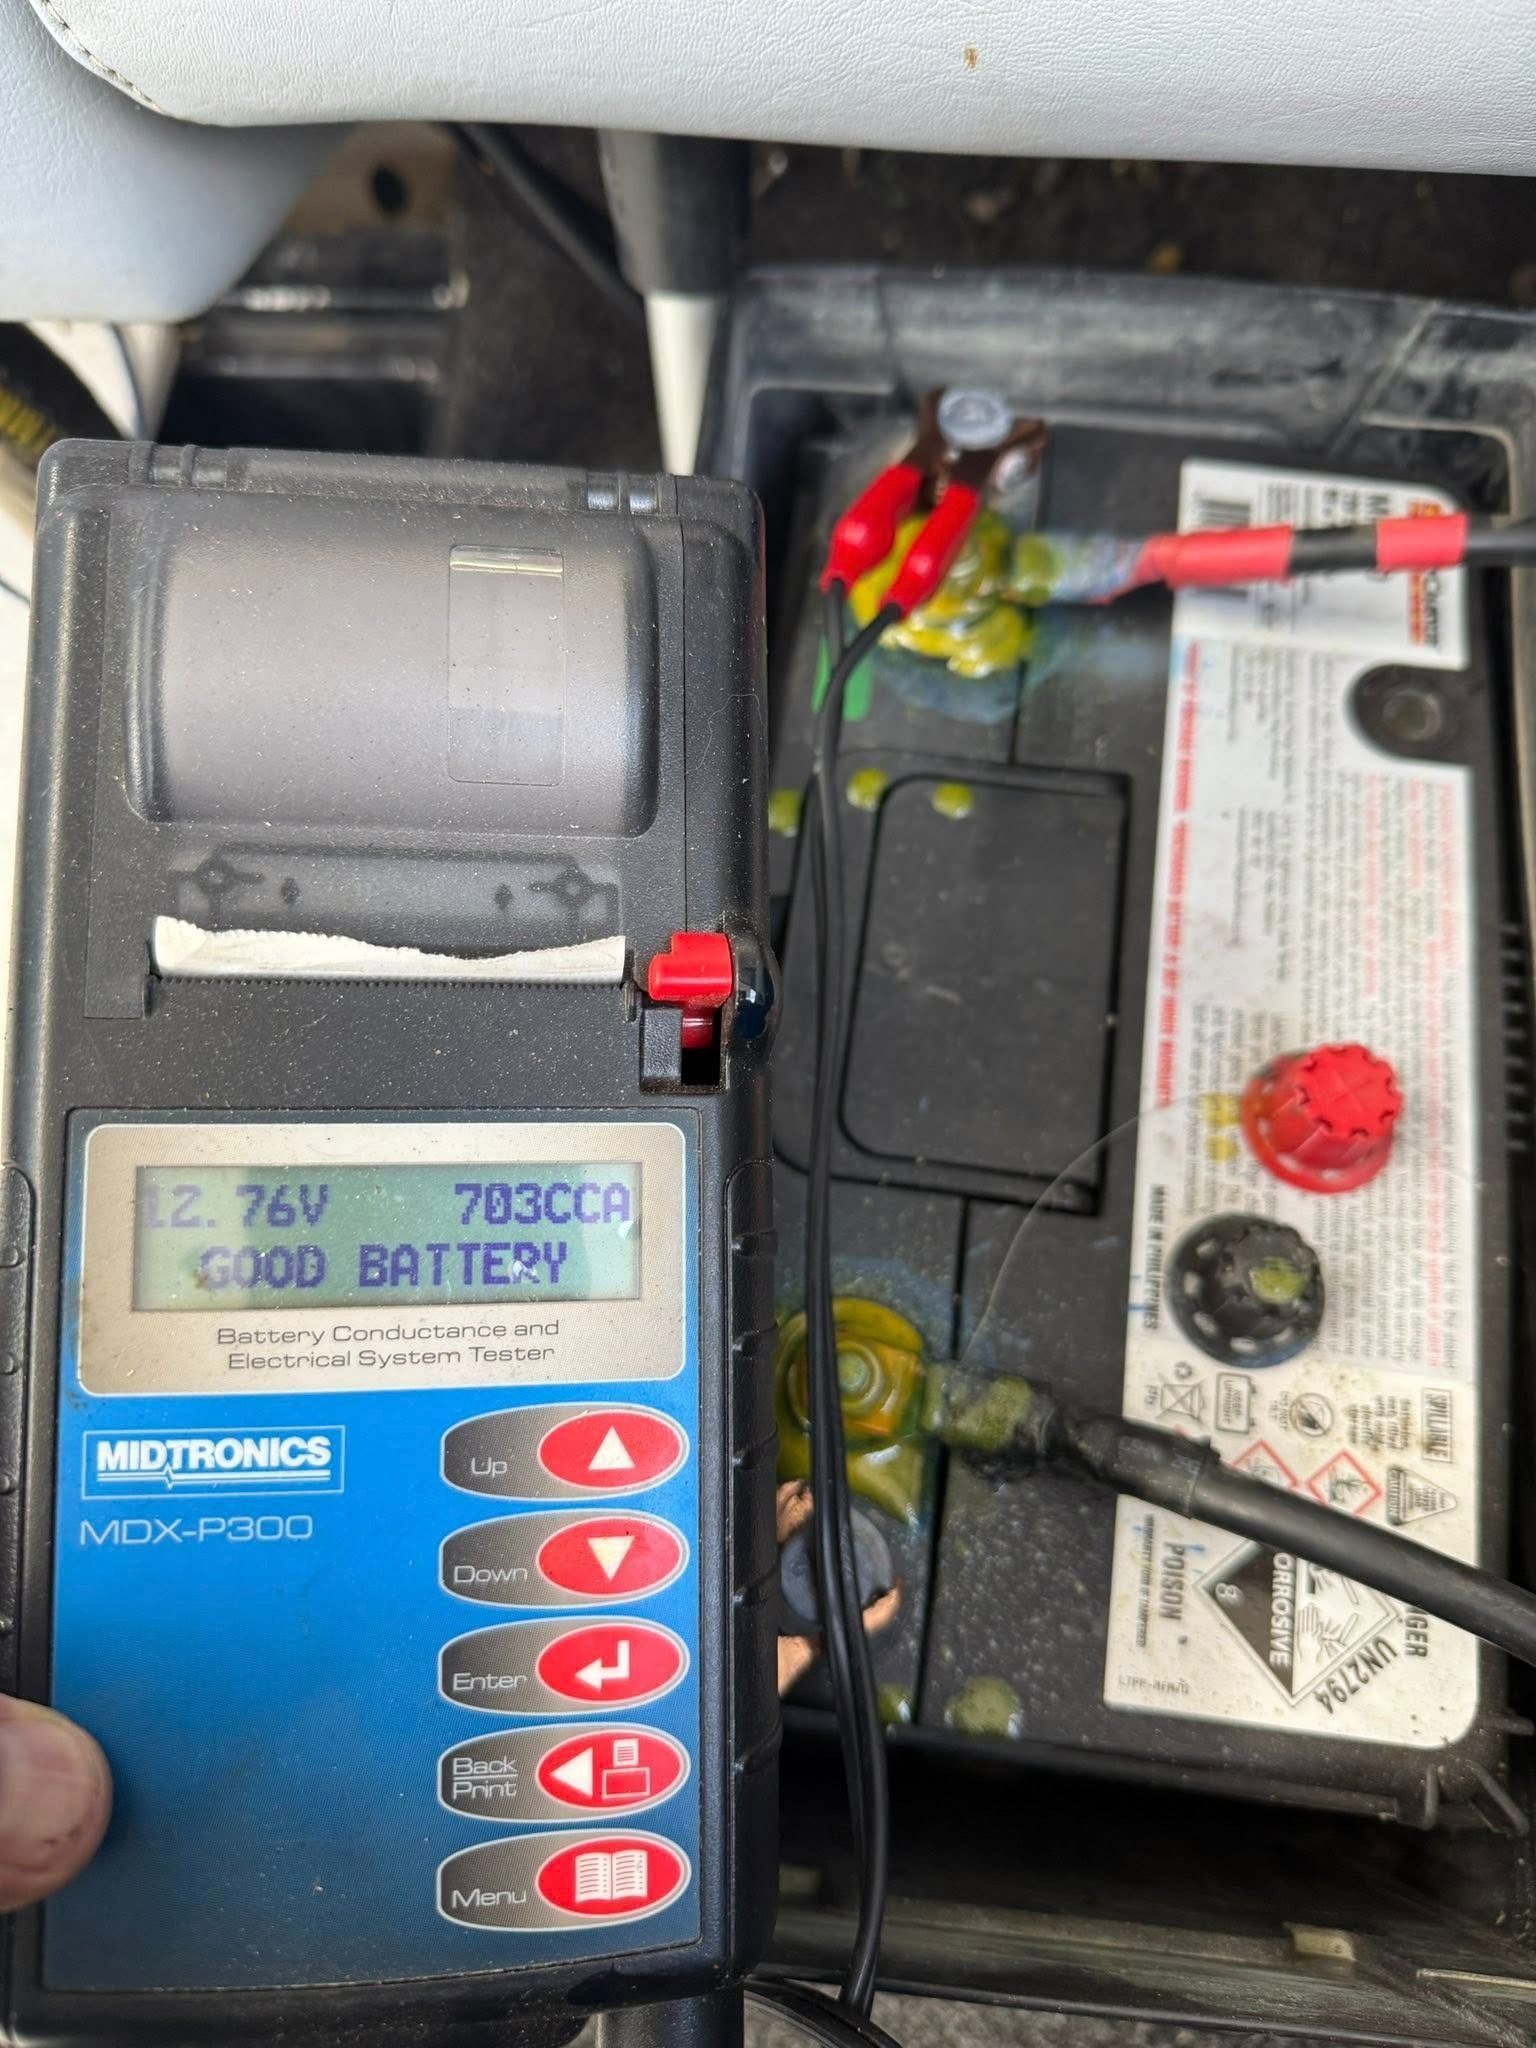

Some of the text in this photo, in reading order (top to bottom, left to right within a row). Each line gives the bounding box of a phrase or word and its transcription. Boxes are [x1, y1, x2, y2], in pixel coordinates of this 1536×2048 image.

[454, 1182, 632, 1226] 703CCA
[201, 1242, 568, 1291] GOOD BATTERY
[1143, 1185, 1166, 1330] MADE IN PHILIPPINES
[218, 1320, 560, 1347] Battery Conductance and
[228, 1346, 556, 1370] Electrical System Tester
[1426, 1394, 1448, 1457] SPILLABLE
[96, 1435, 332, 1474] MIDTRONICS
[470, 1456, 508, 1478] Up
[1388, 1472, 1400, 1516] CAUTION
[79, 1515, 314, 1546] MDX-P300
[453, 1564, 529, 1585] Down
[1159, 1542, 1186, 1621] POISON
[1215, 1583, 1245, 1606] 8
[1269, 1553, 1293, 1666] ORROSIVE
[452, 1670, 528, 1691] Enter
[1313, 1636, 1399, 1715] UN2794
[451, 1754, 518, 1776] Back
[451, 1779, 518, 1799] Print
[451, 1888, 528, 1908] Menu
